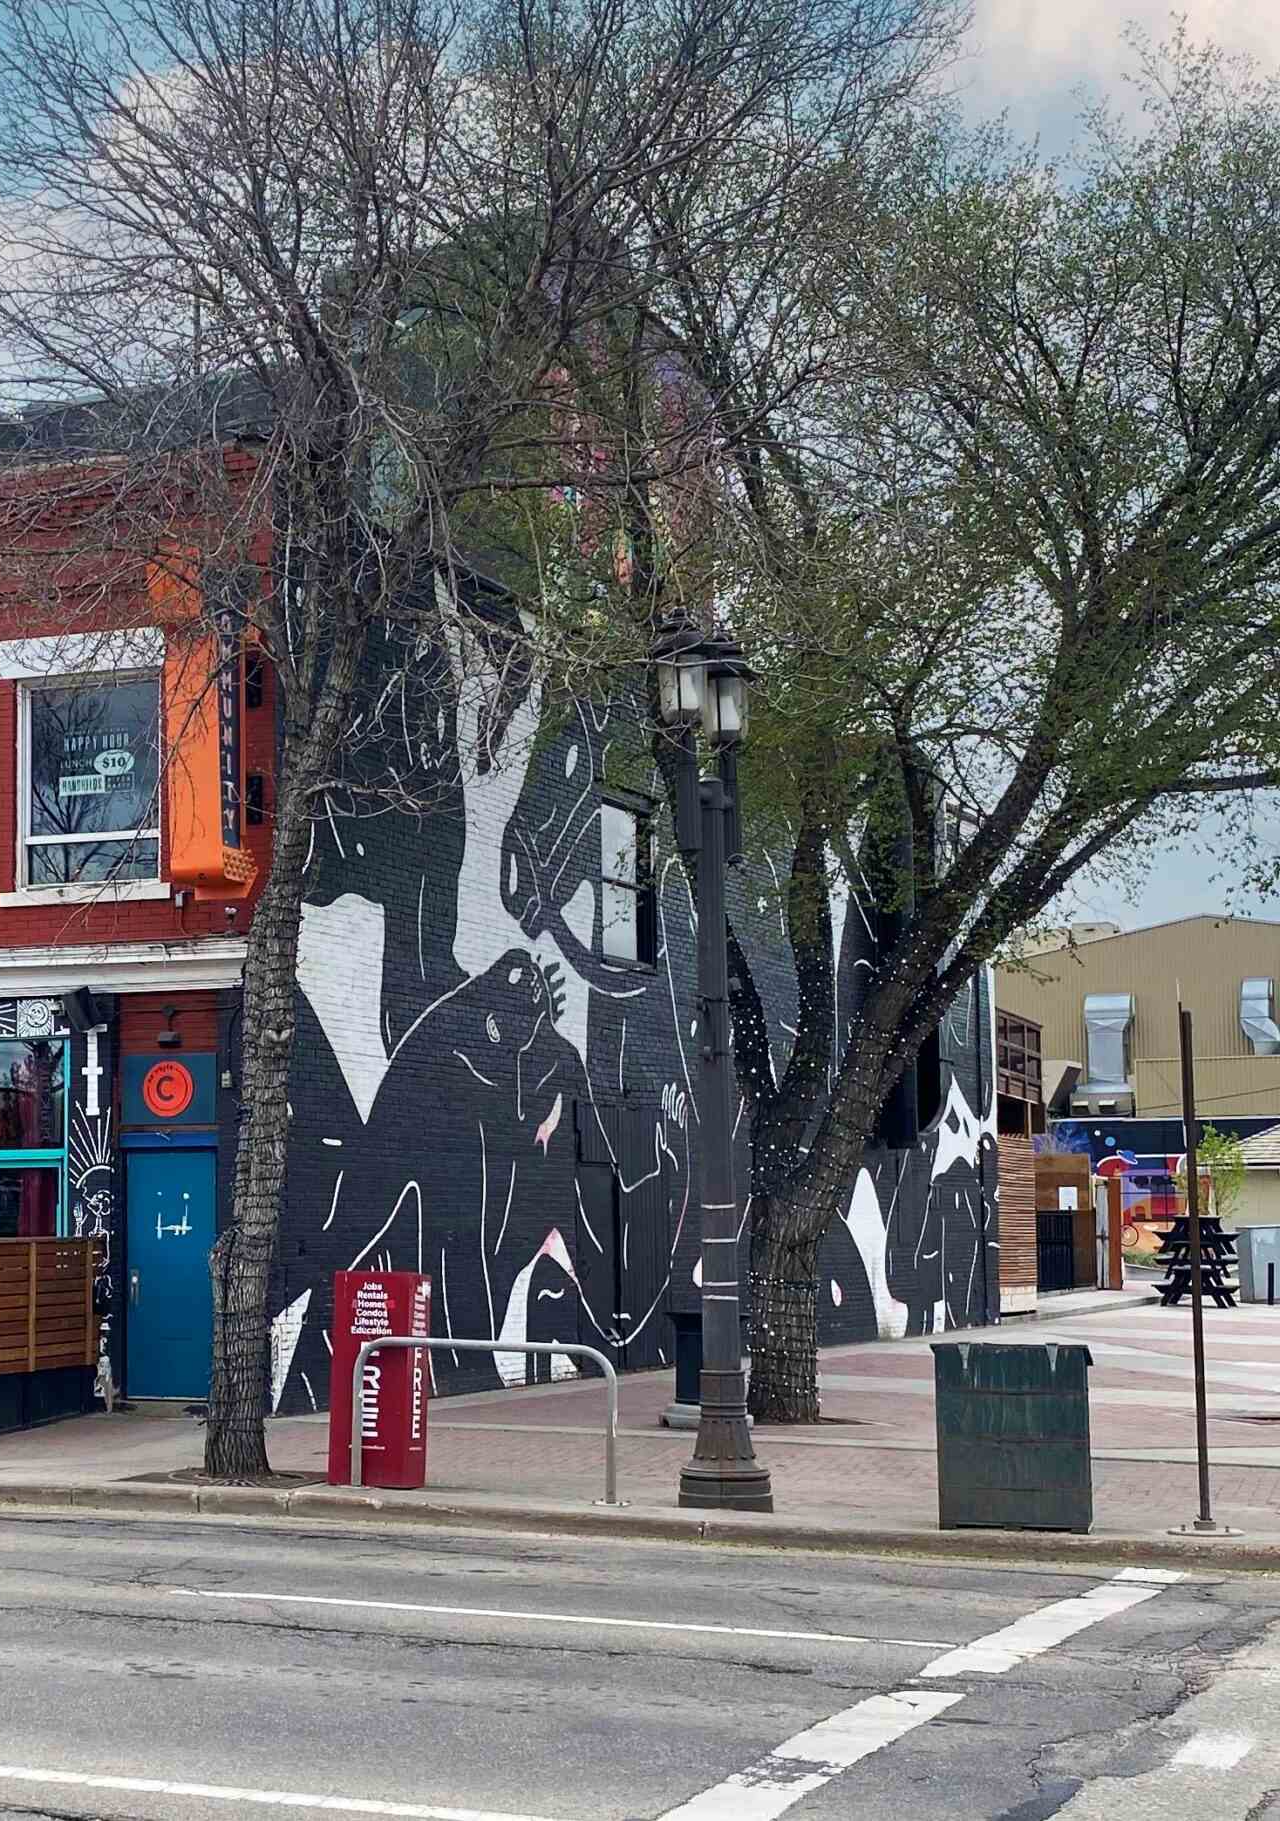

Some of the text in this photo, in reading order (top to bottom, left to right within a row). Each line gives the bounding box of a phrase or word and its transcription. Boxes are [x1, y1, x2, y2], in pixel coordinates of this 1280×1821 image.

[221, 590, 234, 831] OMMUNITY
[64, 732, 129, 752] HAPPY HOUR
[102, 756, 126, 769] $10
[156, 1075, 175, 1101] C
[363, 1282, 382, 1290] Jobs
[357, 1291, 388, 1299] Rentals
[357, 1300, 387, 1308] Homes
[356, 1309, 388, 1317] Condos
[354, 1317, 389, 1326] Lifestyle
[351, 1326, 392, 1335] Education
[412, 1346, 422, 1439] FREE
